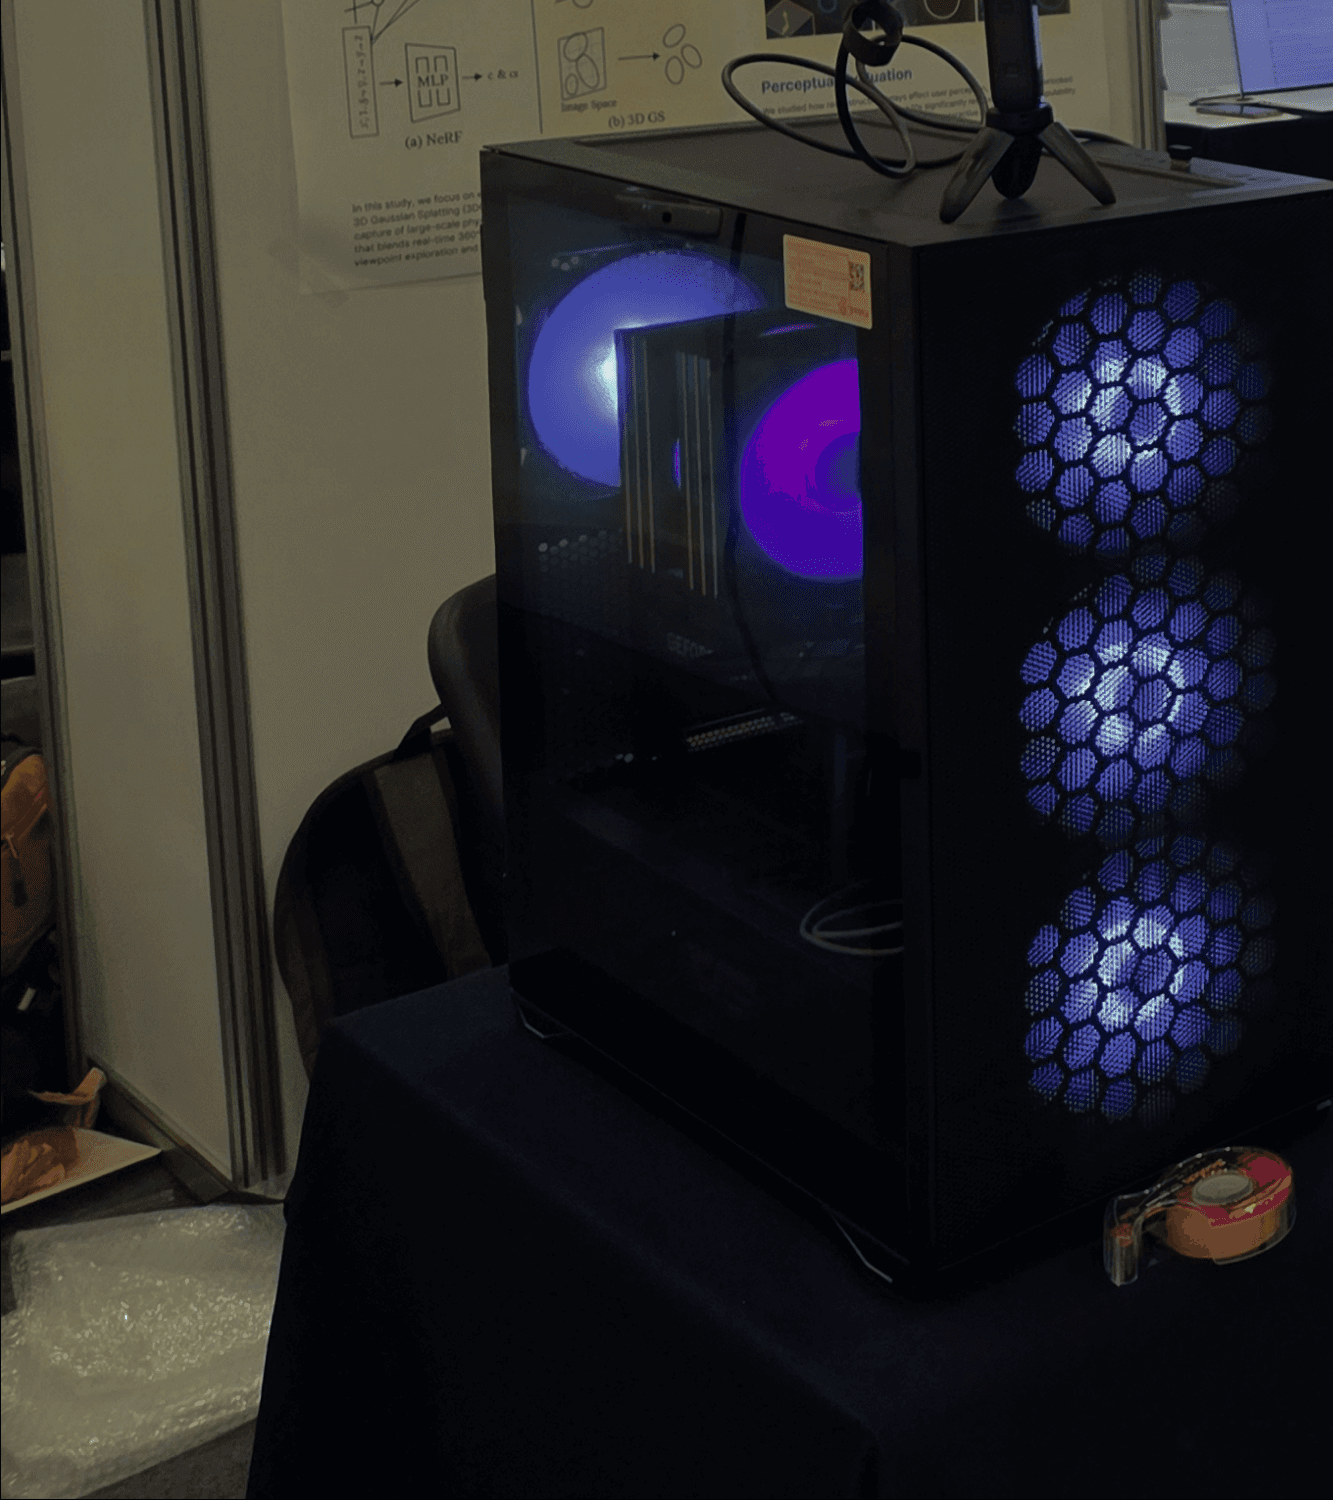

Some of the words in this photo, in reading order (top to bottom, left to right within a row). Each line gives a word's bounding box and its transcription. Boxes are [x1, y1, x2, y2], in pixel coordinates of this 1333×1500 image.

[417, 73, 448, 87] MLP
[761, 76, 837, 94] Perceptua
[560, 102, 588, 112] Image
[590, 99, 616, 110] Space
[607, 115, 625, 128] (b)
[627, 112, 645, 125] 3D
[647, 110, 665, 123] GS
[404, 135, 422, 149] (a)
[426, 130, 462, 145] NeRF
[462, 202, 480, 214] (3D
[462, 218, 479, 230] phy
